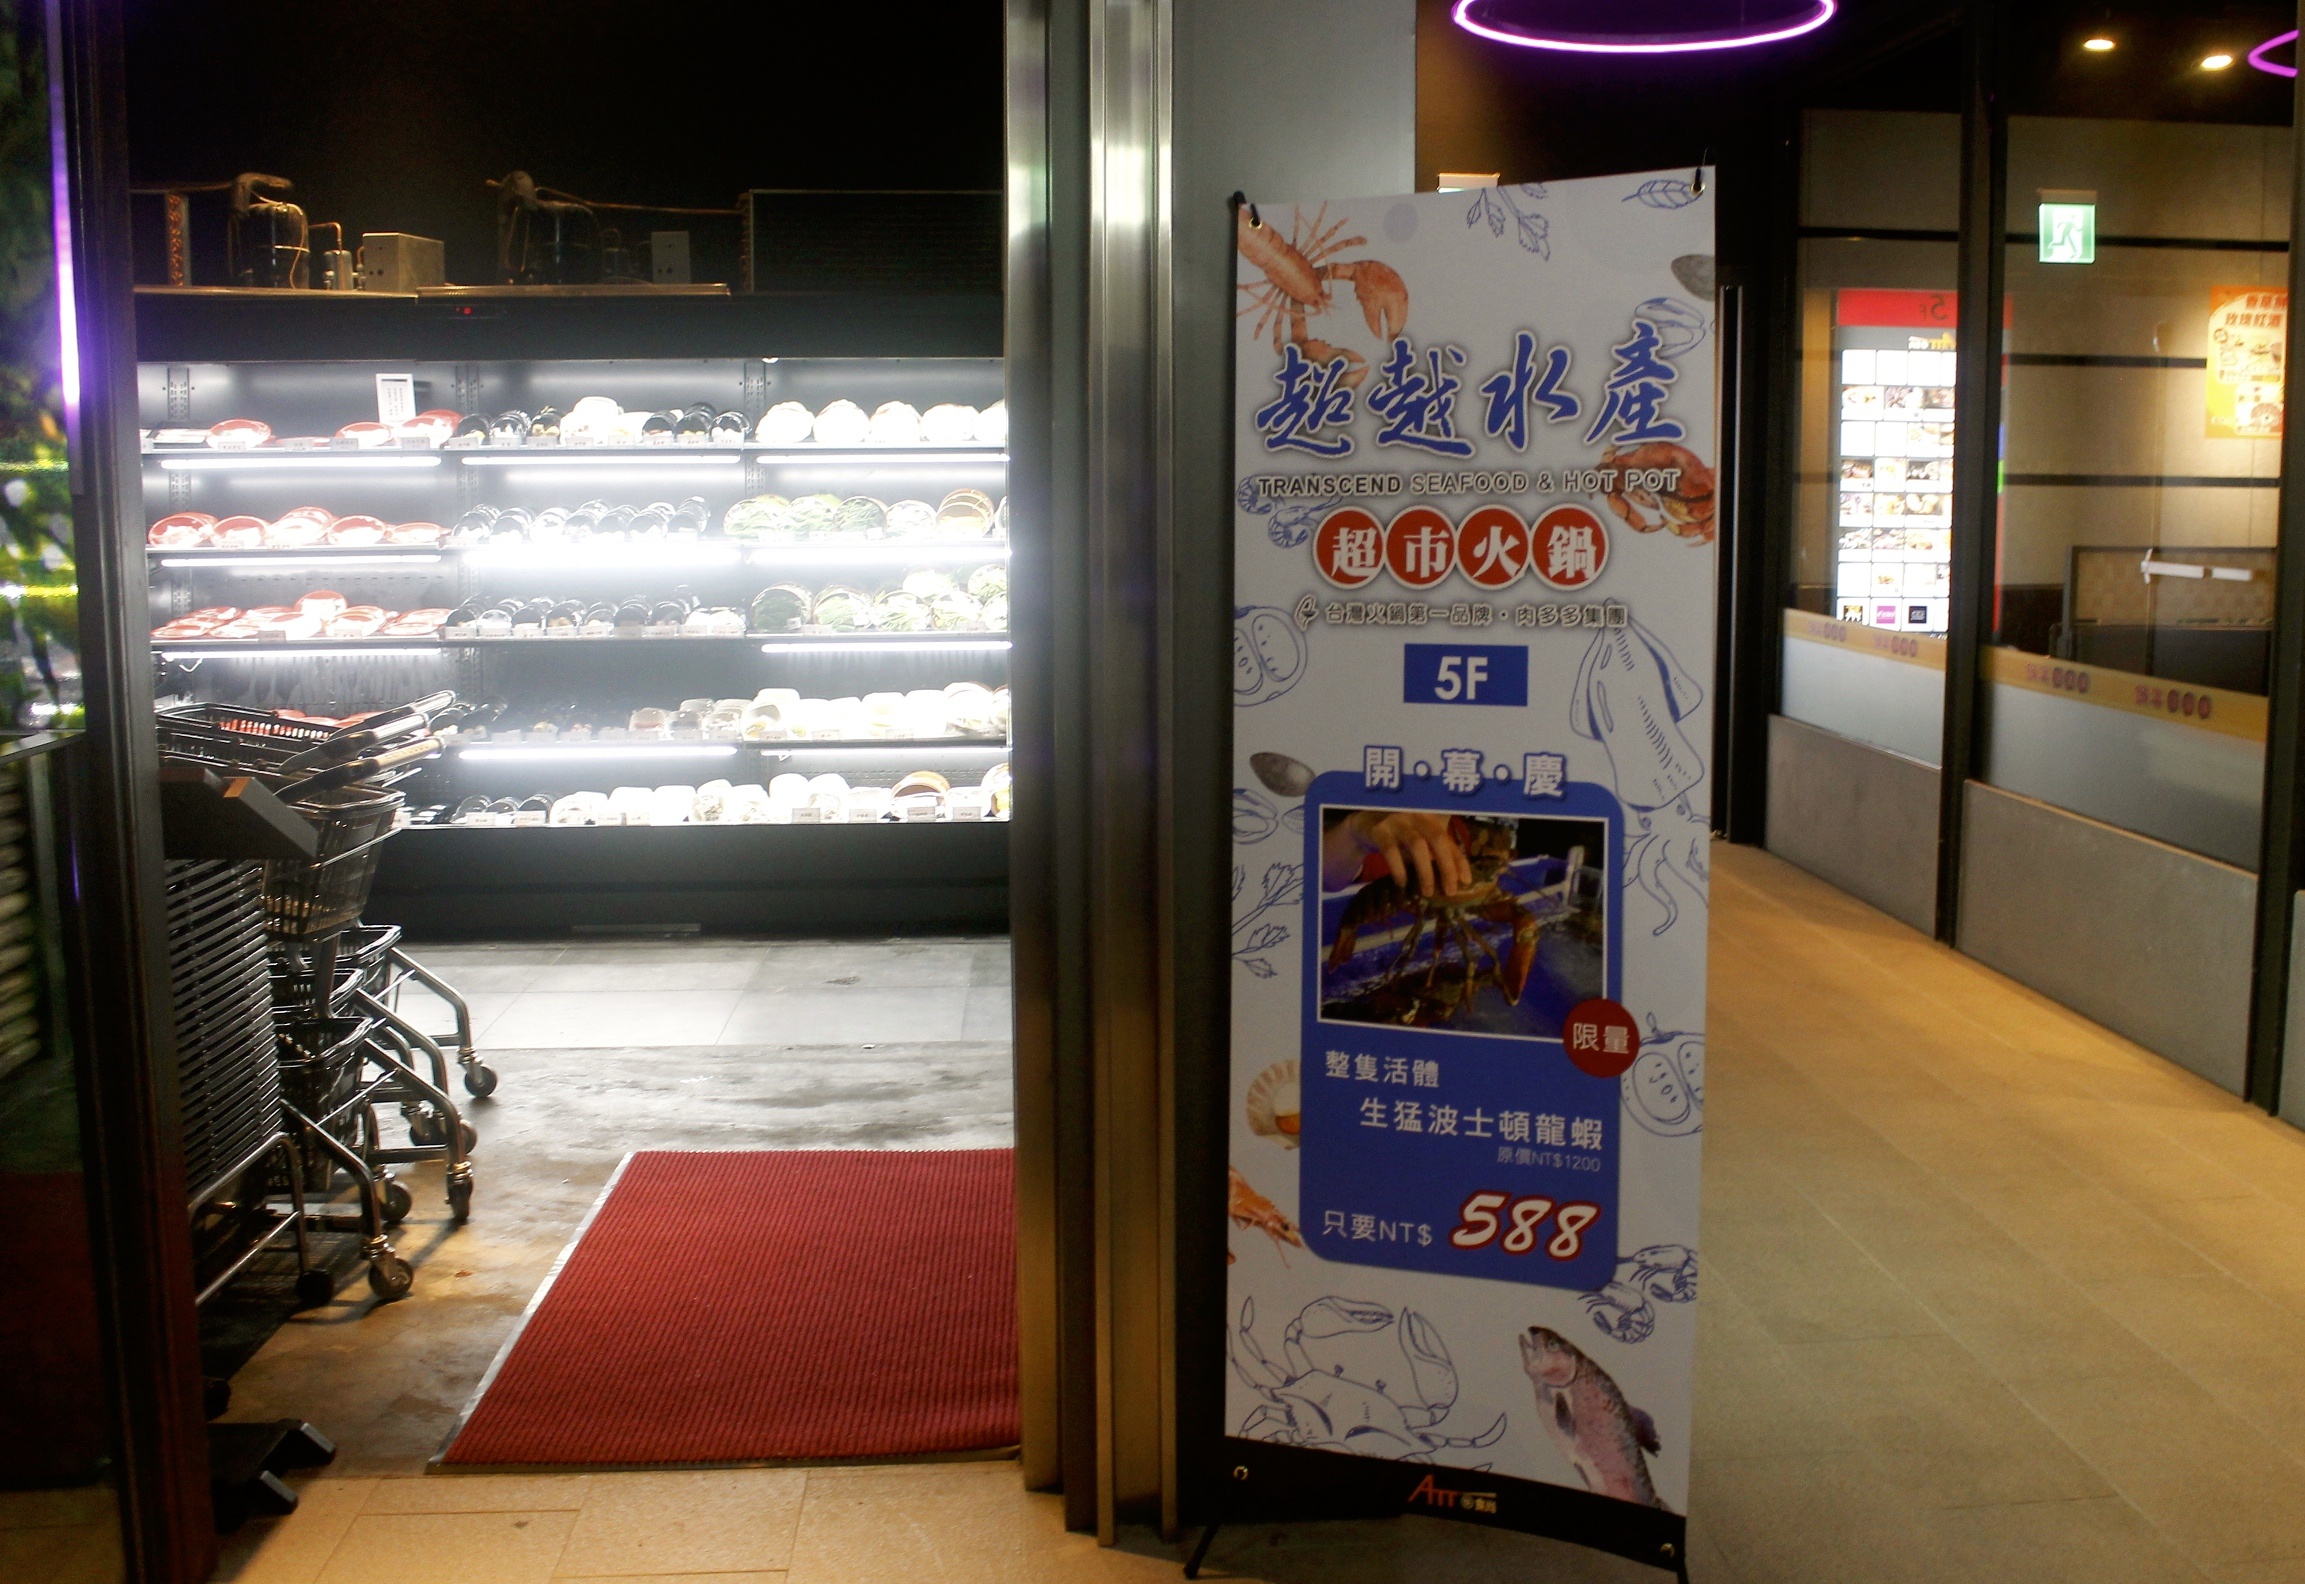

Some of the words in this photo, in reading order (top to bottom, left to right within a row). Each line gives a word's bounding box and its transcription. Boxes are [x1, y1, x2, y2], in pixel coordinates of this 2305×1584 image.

[1256, 319, 1686, 457] 超越水產
[1259, 475, 1401, 495] TRANSCEND
[1410, 473, 1528, 493] SEAFOOD
[1538, 473, 1553, 491] &
[1564, 471, 1616, 491] HOT
[1624, 469, 1681, 492] POT
[1331, 524, 1596, 580] 超市火鍋
[1435, 657, 1489, 700] 5F
[1572, 1022, 1630, 1055] 限量
[1325, 1050, 1440, 1088] 整隻活體
[1360, 1097, 1602, 1150] 生猛波士頓龍蝦
[1323, 1210, 1432, 1246] 只要NT$
[1448, 1190, 1601, 1260] 588
